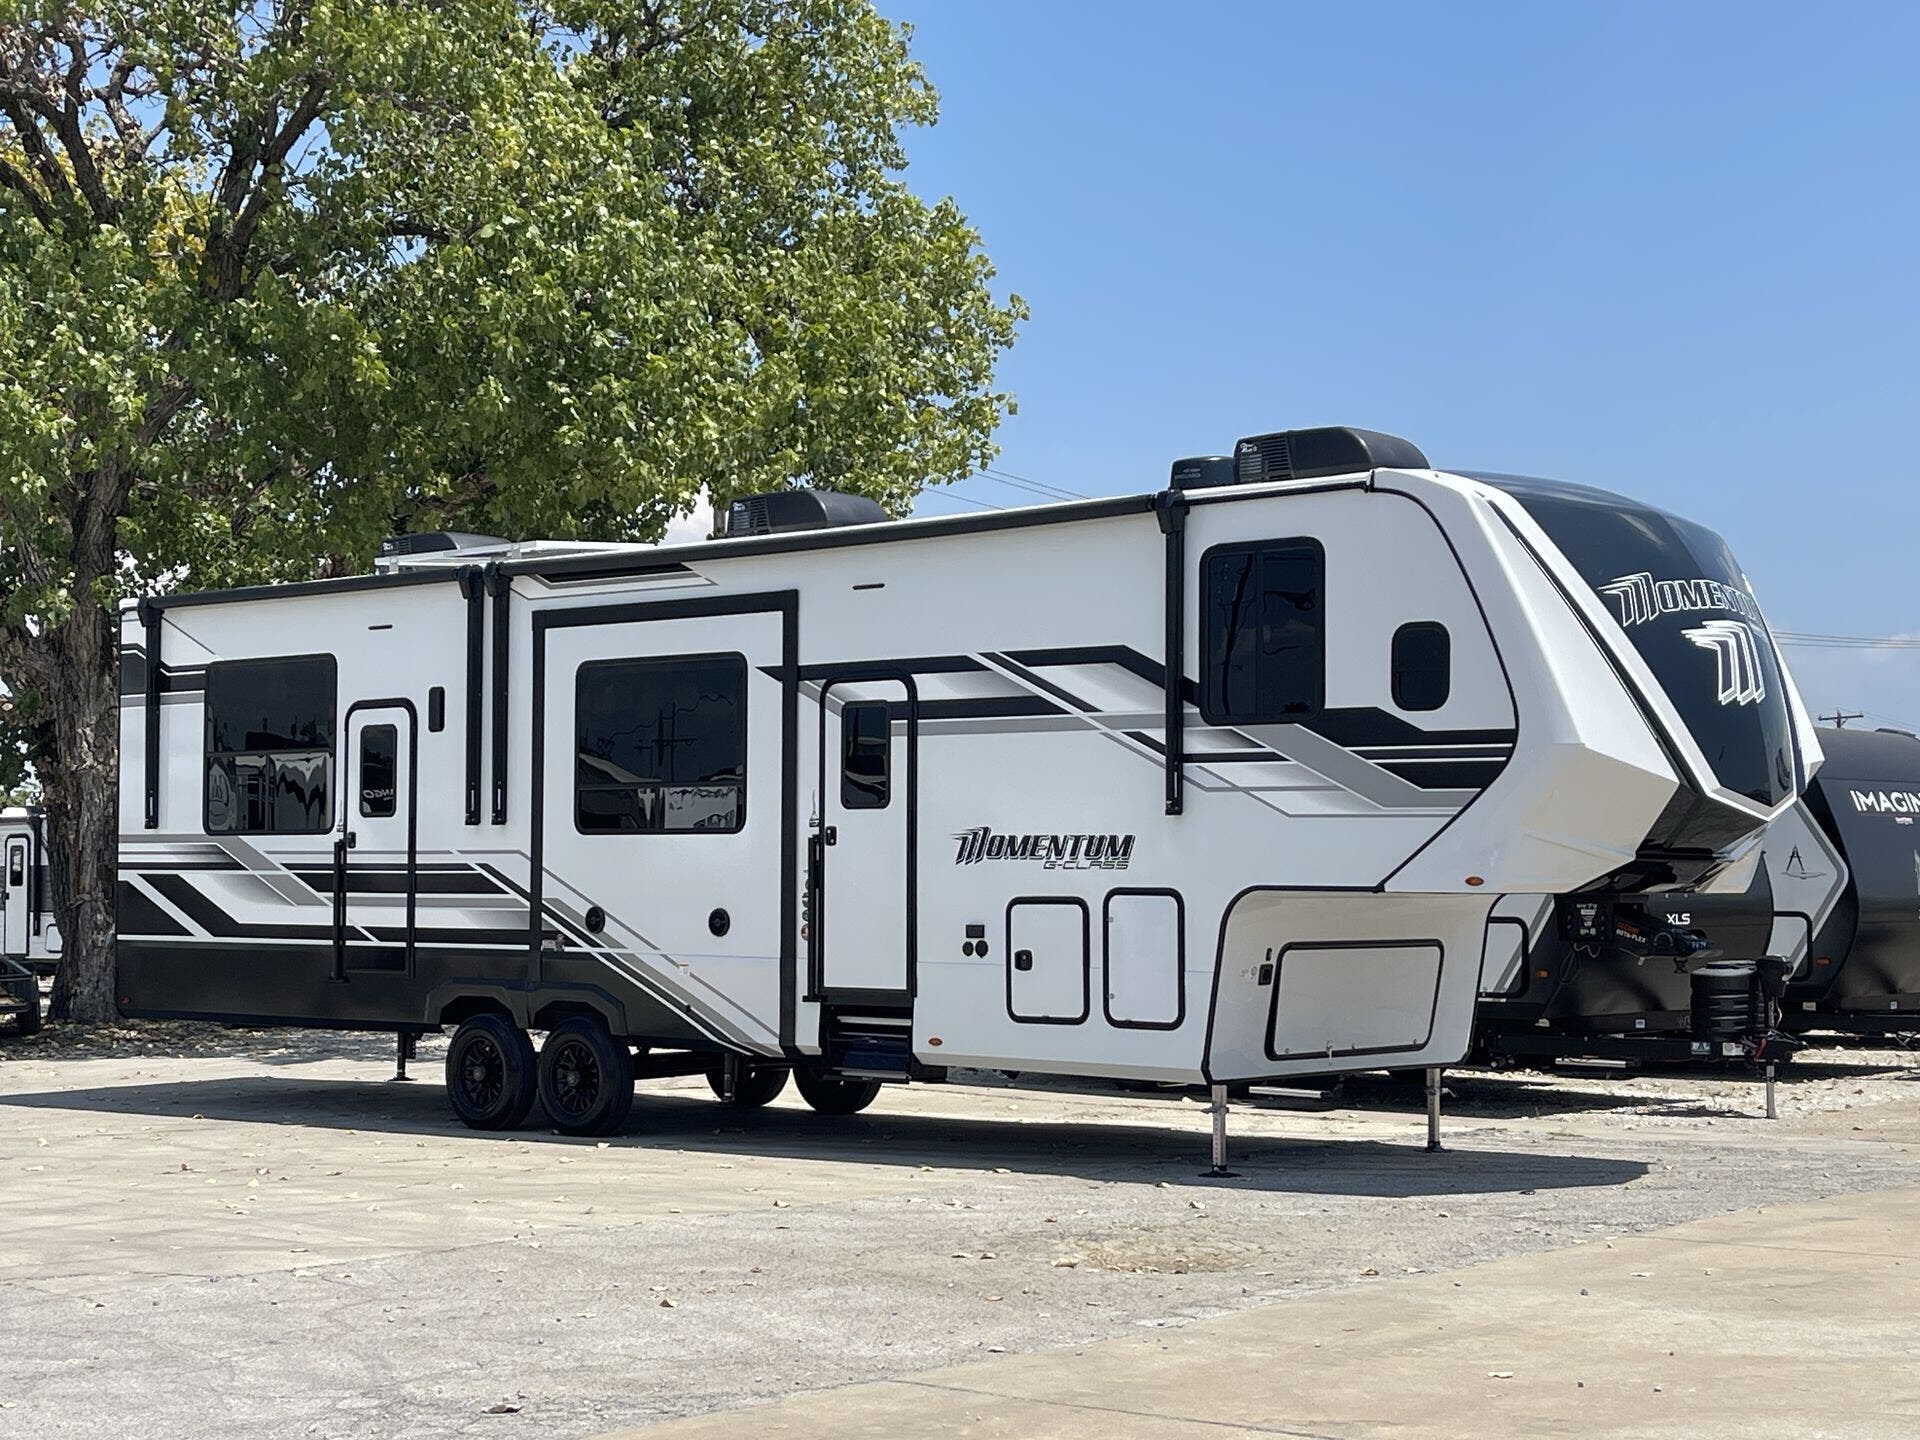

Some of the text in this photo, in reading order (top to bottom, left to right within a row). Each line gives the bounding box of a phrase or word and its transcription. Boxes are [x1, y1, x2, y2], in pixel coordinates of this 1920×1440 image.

[1597, 572, 1758, 627] MOMENTU
[950, 826, 1137, 865] MOMENTUM
[1043, 860, 1130, 871] G-CLASS
[1667, 913, 1691, 925] XLS
